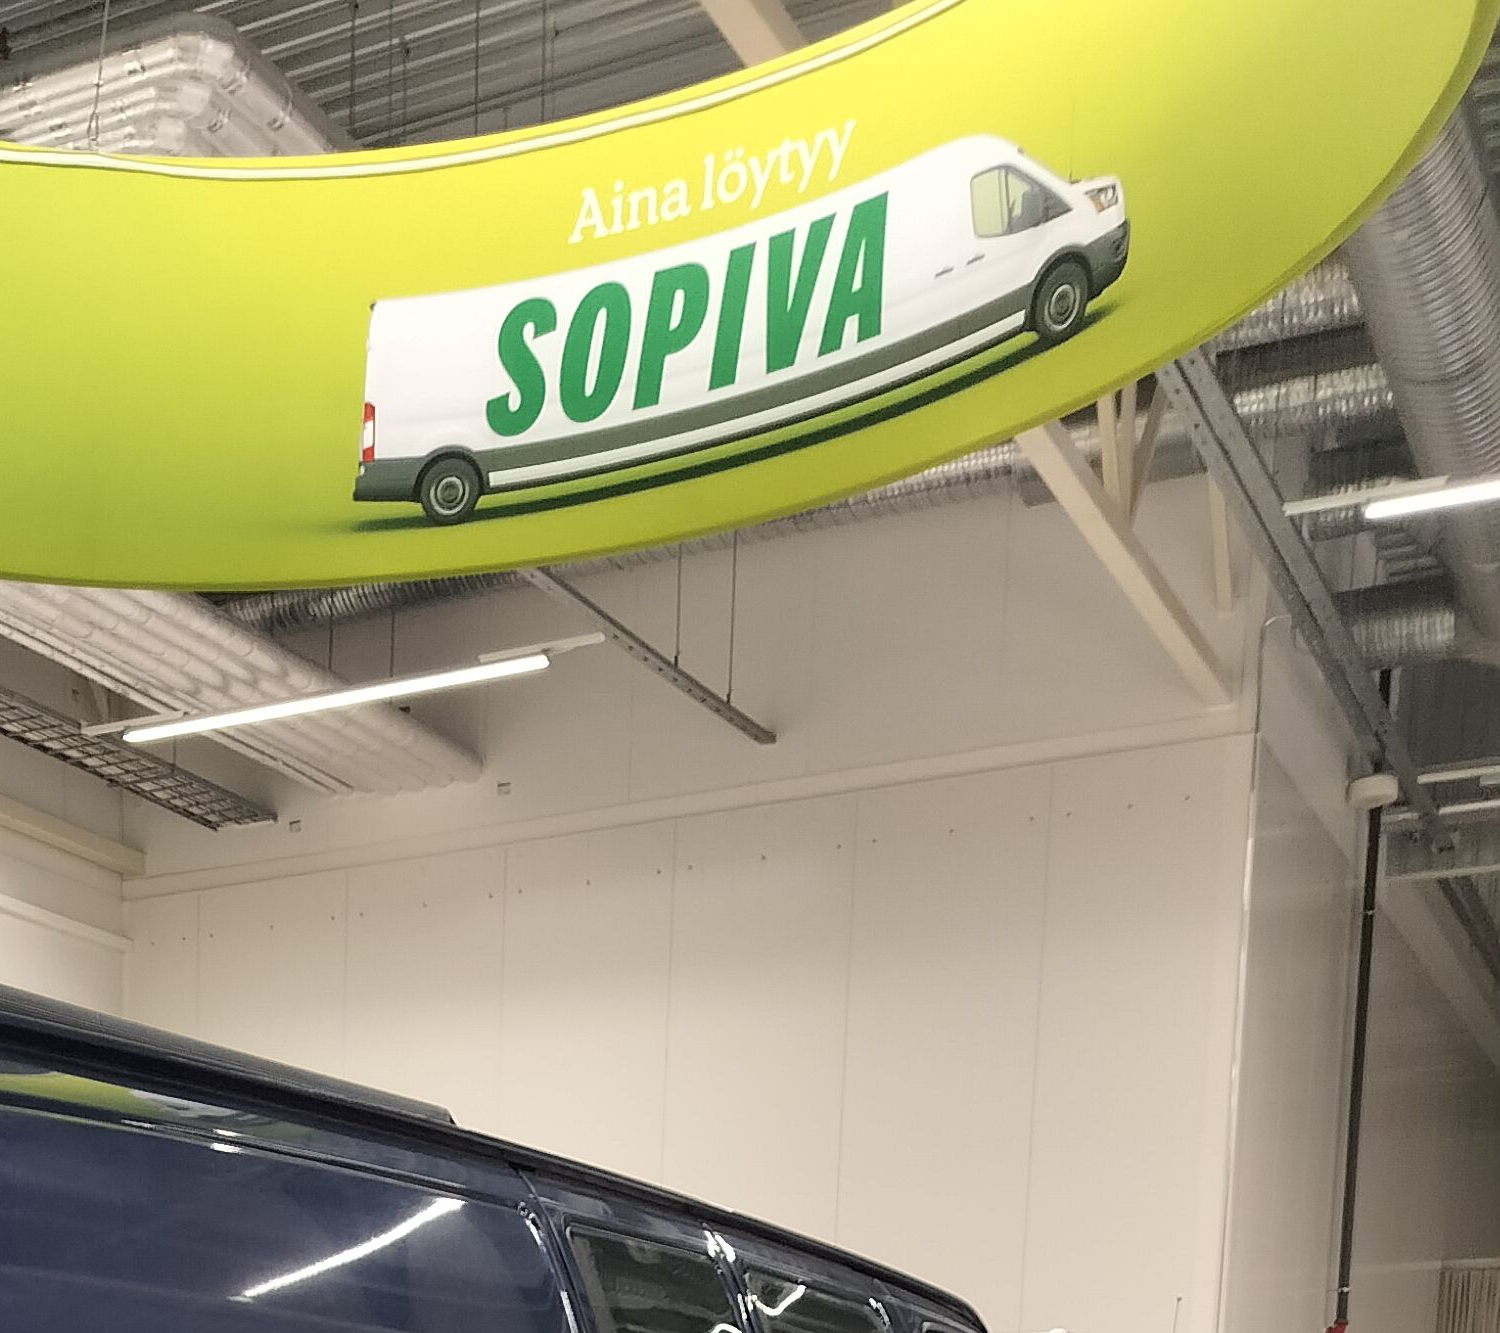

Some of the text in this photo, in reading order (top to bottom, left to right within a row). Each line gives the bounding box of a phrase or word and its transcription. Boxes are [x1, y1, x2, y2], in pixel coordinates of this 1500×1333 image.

[567, 118, 857, 244] Aina löytyy
[485, 190, 889, 437] SOPIVA
